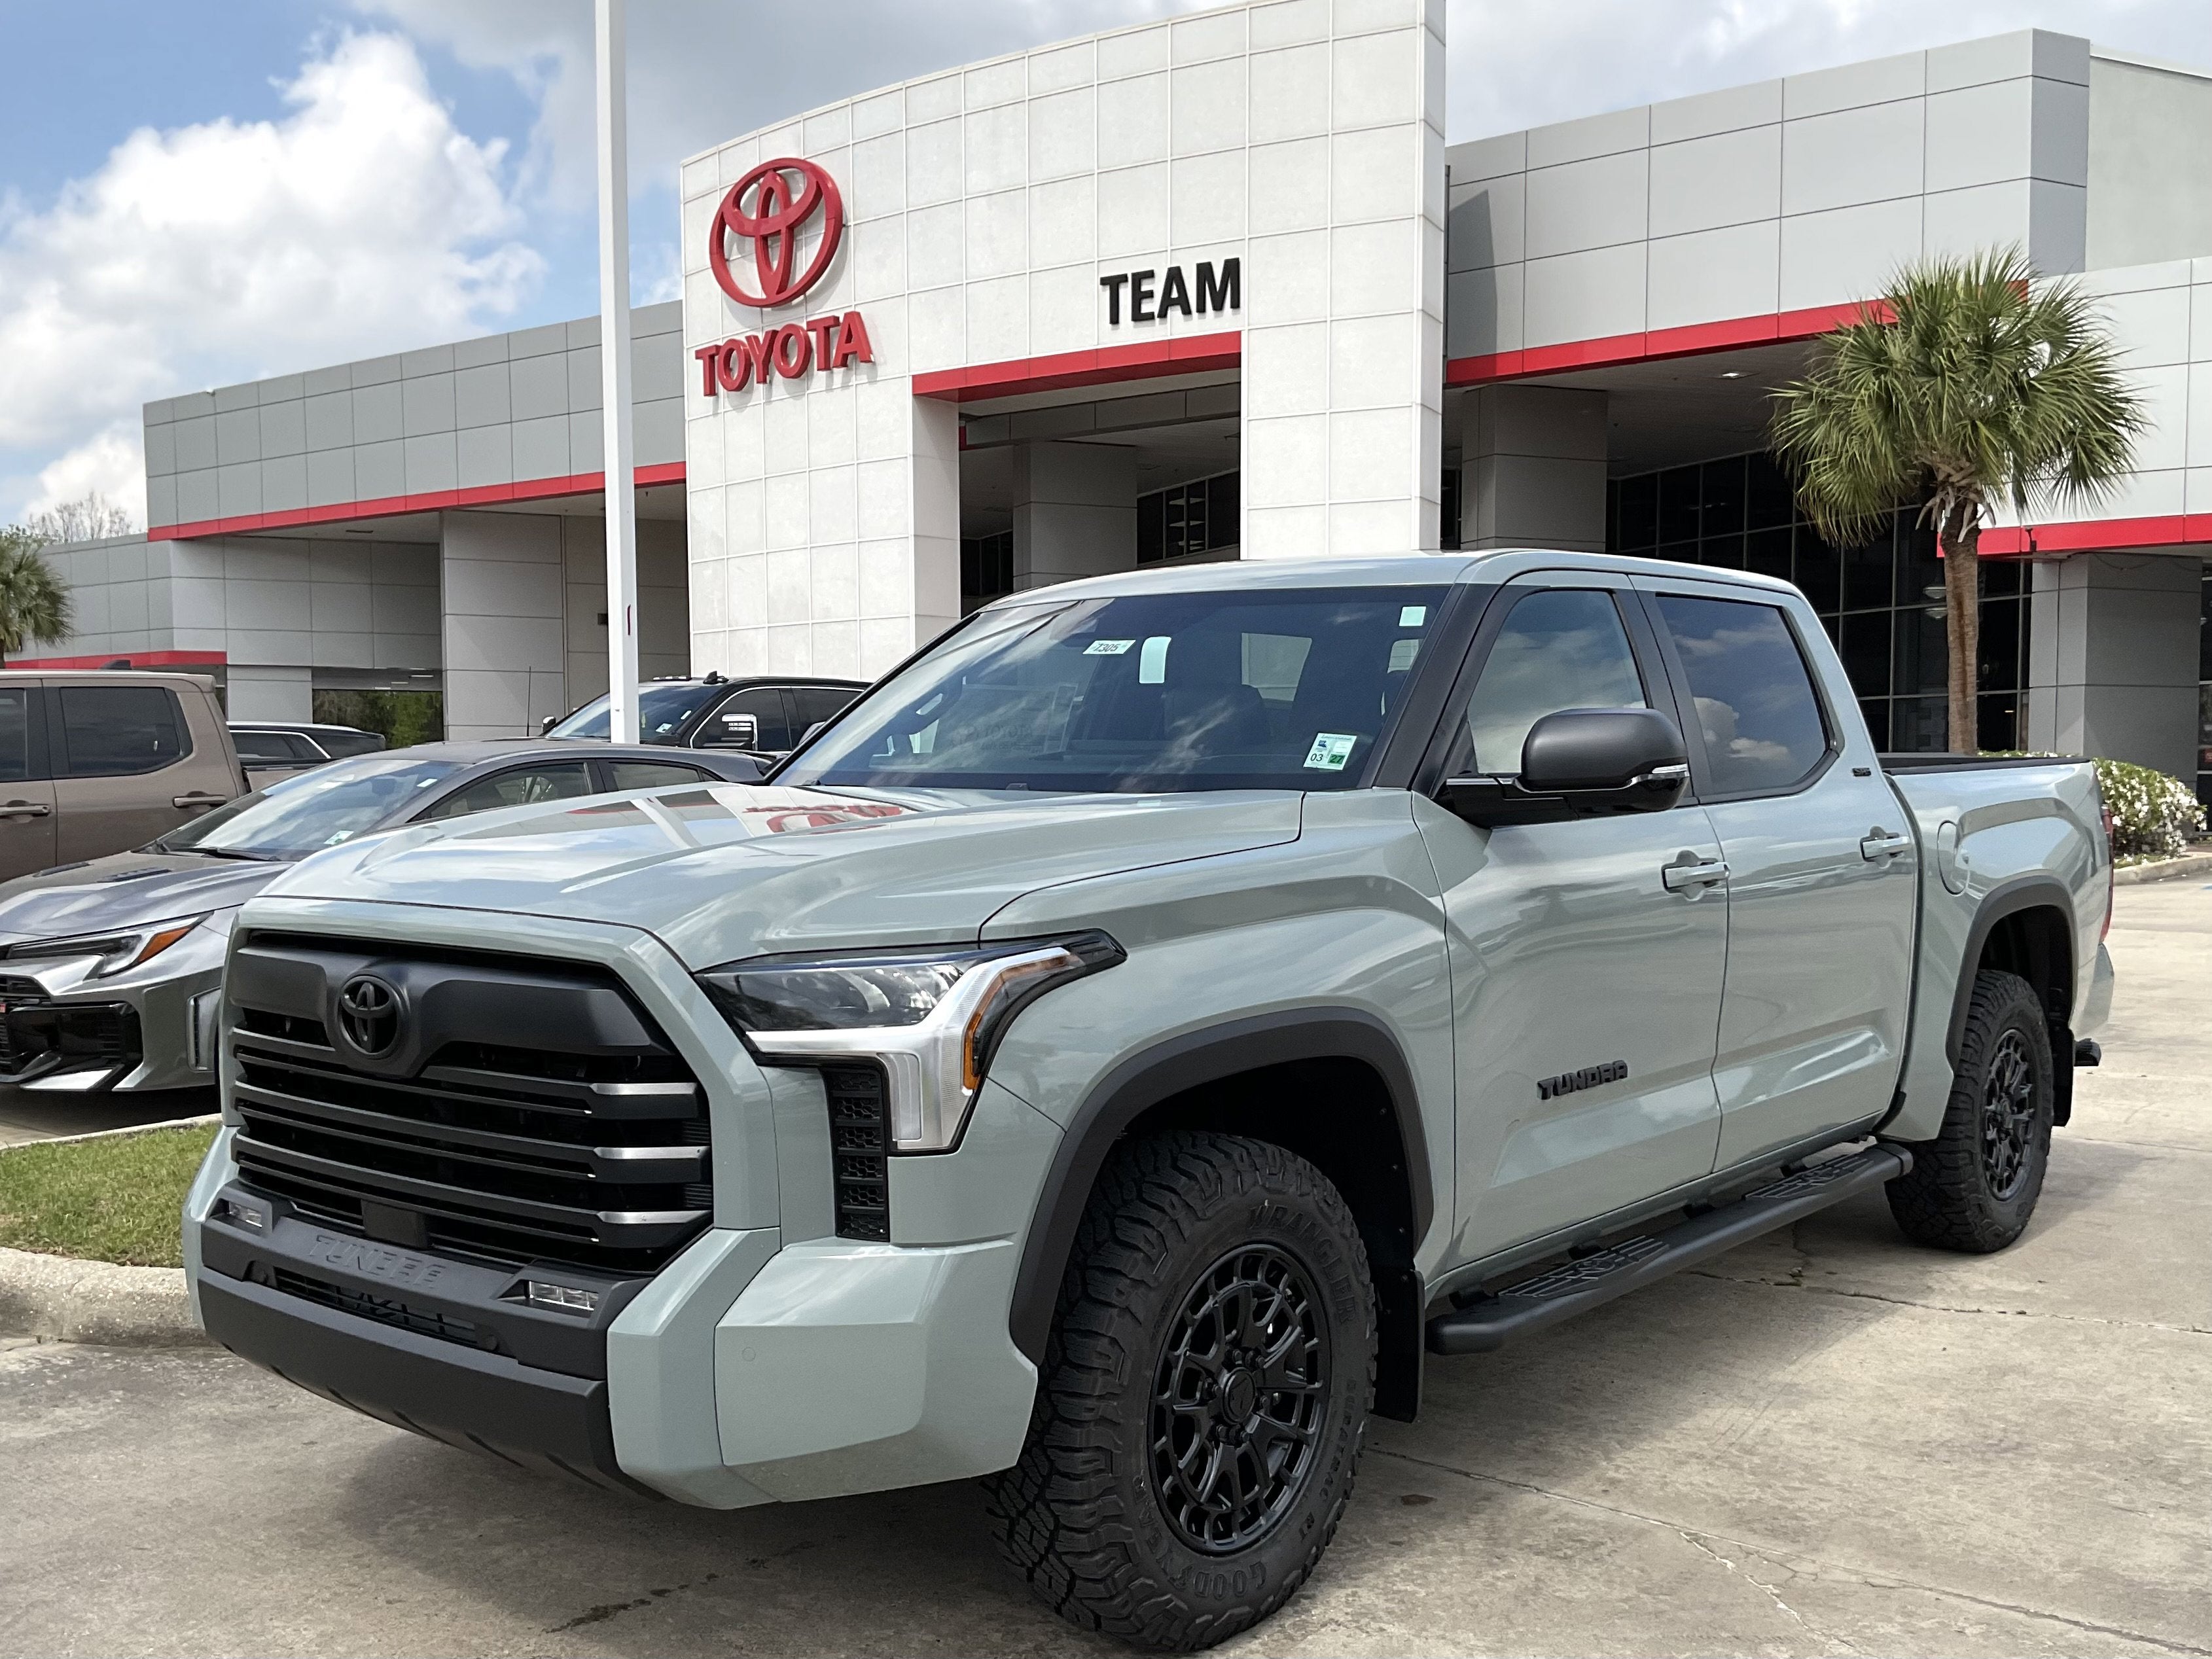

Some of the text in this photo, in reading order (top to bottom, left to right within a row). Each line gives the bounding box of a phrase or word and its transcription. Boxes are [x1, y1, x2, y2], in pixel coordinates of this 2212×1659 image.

[1100, 257, 1241, 325] TEAM
[695, 311, 874, 397] TOYOTA
[1329, 755, 1345, 764] 27
[1537, 1060, 1628, 1100] TUNDRA
[309, 1234, 446, 1289] TUNDRA
[1248, 1203, 1357, 1325] WRANGLER
[1132, 1474, 1267, 1601] GOODYEAR
